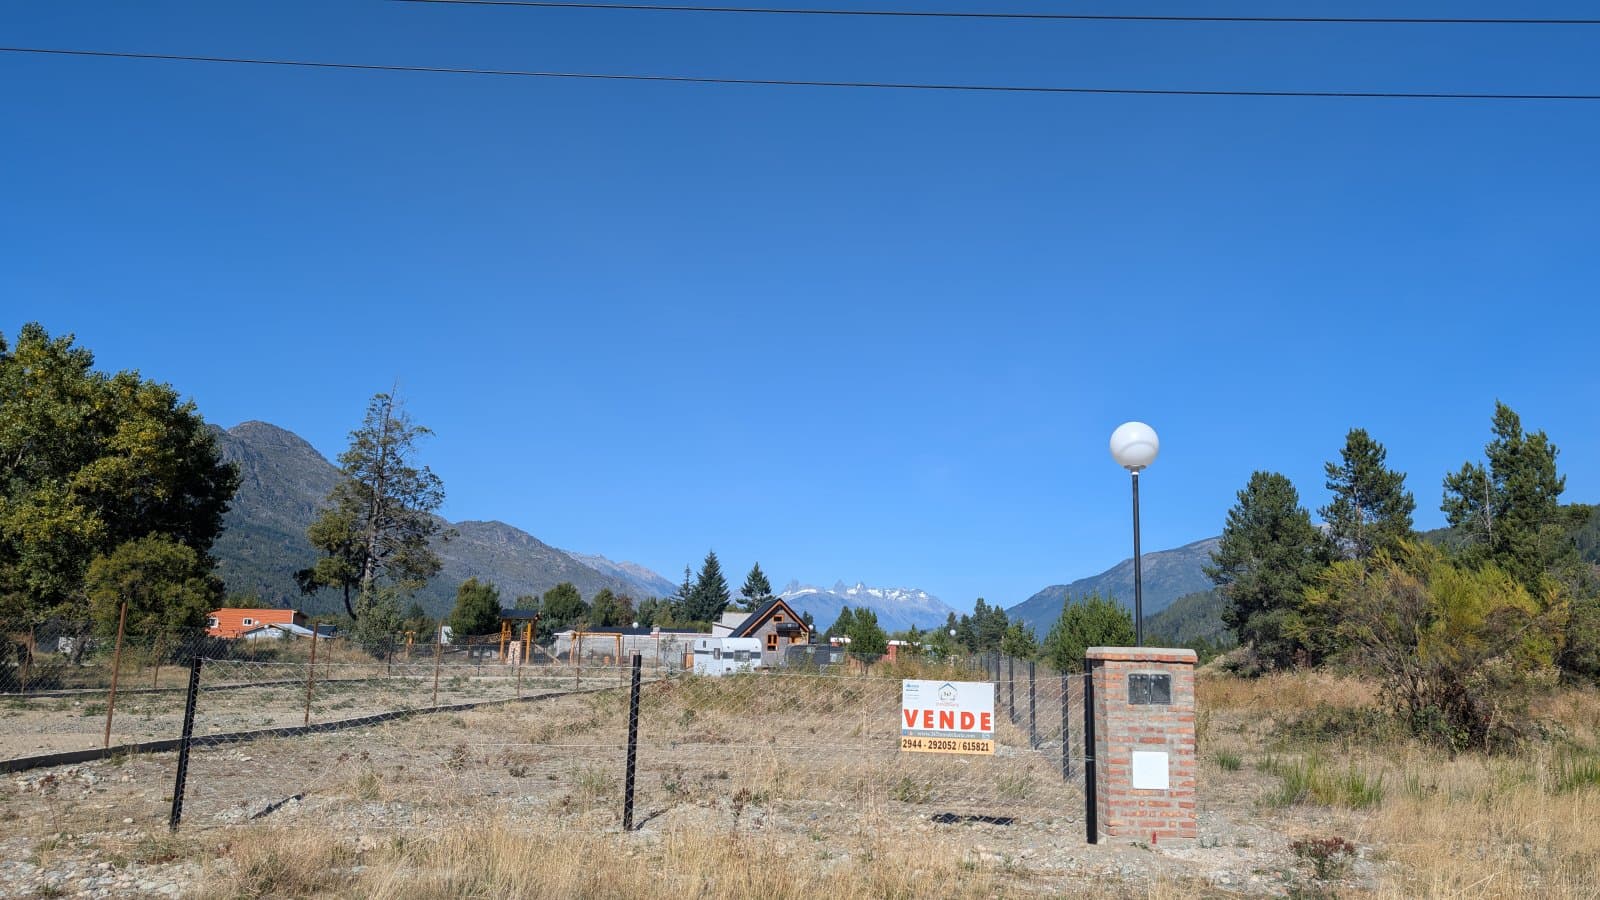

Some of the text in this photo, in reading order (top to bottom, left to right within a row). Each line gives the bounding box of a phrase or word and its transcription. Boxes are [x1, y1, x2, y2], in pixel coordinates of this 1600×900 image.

[903, 709, 991, 731] VENDE
[902, 739, 922, 748] 2944
[928, 740, 956, 751] 292052
[962, 742, 990, 752] 615821
